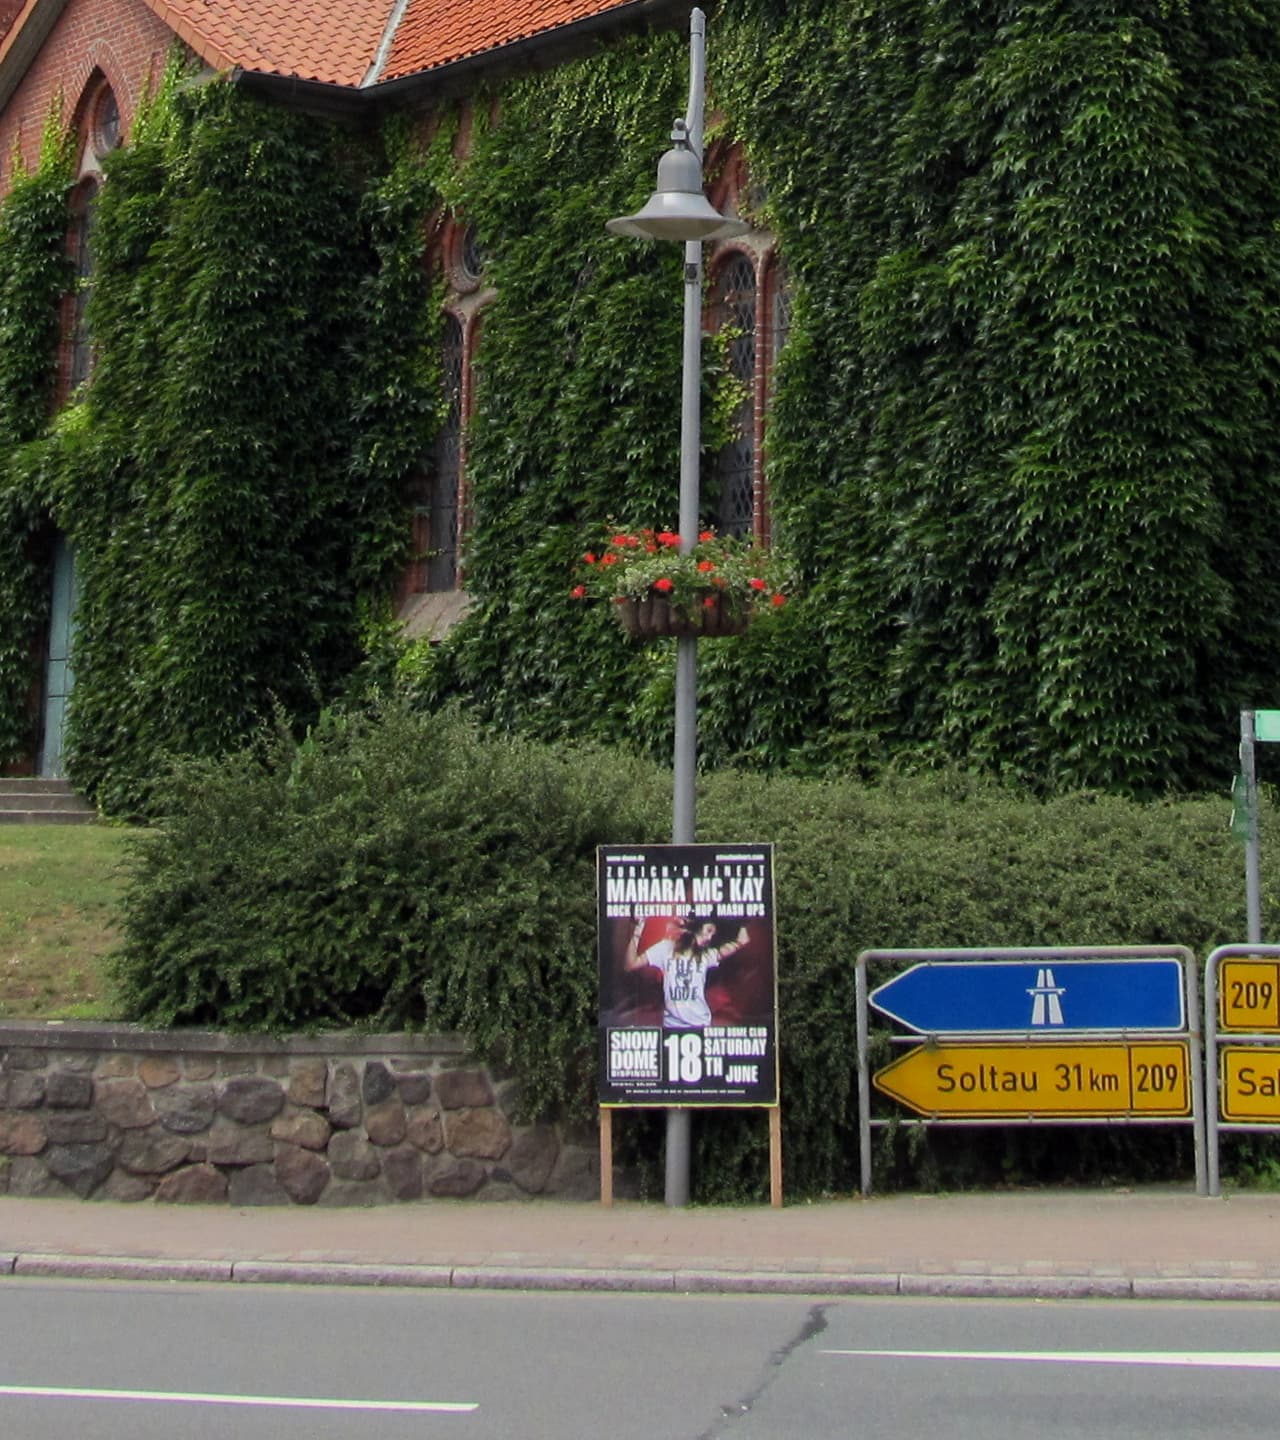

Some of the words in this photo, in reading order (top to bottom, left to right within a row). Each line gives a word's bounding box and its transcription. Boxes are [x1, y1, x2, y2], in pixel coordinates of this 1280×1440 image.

[704, 864, 765, 877] FINEST
[606, 878, 686, 903] MAHARA
[692, 877, 724, 902] MC
[730, 877, 765, 902] KAY
[606, 904, 631, 917] ROCK
[634, 904, 673, 917] ELEKTRO
[675, 903, 714, 917] HIP-HOP
[717, 903, 745, 916] MASH
[746, 903, 765, 916] UPS
[1231, 981, 1273, 1009] 209
[610, 1031, 659, 1050] SNOW
[703, 1027, 726, 1037] SNOW
[727, 1027, 748, 1037] DOME
[749, 1027, 768, 1037] CLUB
[703, 1038, 767, 1056] SATURDAY
[610, 1050, 658, 1070] DOME
[664, 1033, 703, 1083] 18
[704, 1057, 723, 1077] TH
[725, 1065, 759, 1083] JUNE
[936, 1063, 1038, 1092] Soltau
[1054, 1063, 1082, 1092] 31
[1089, 1067, 1119, 1092] km
[1136, 1064, 1178, 1092] 209
